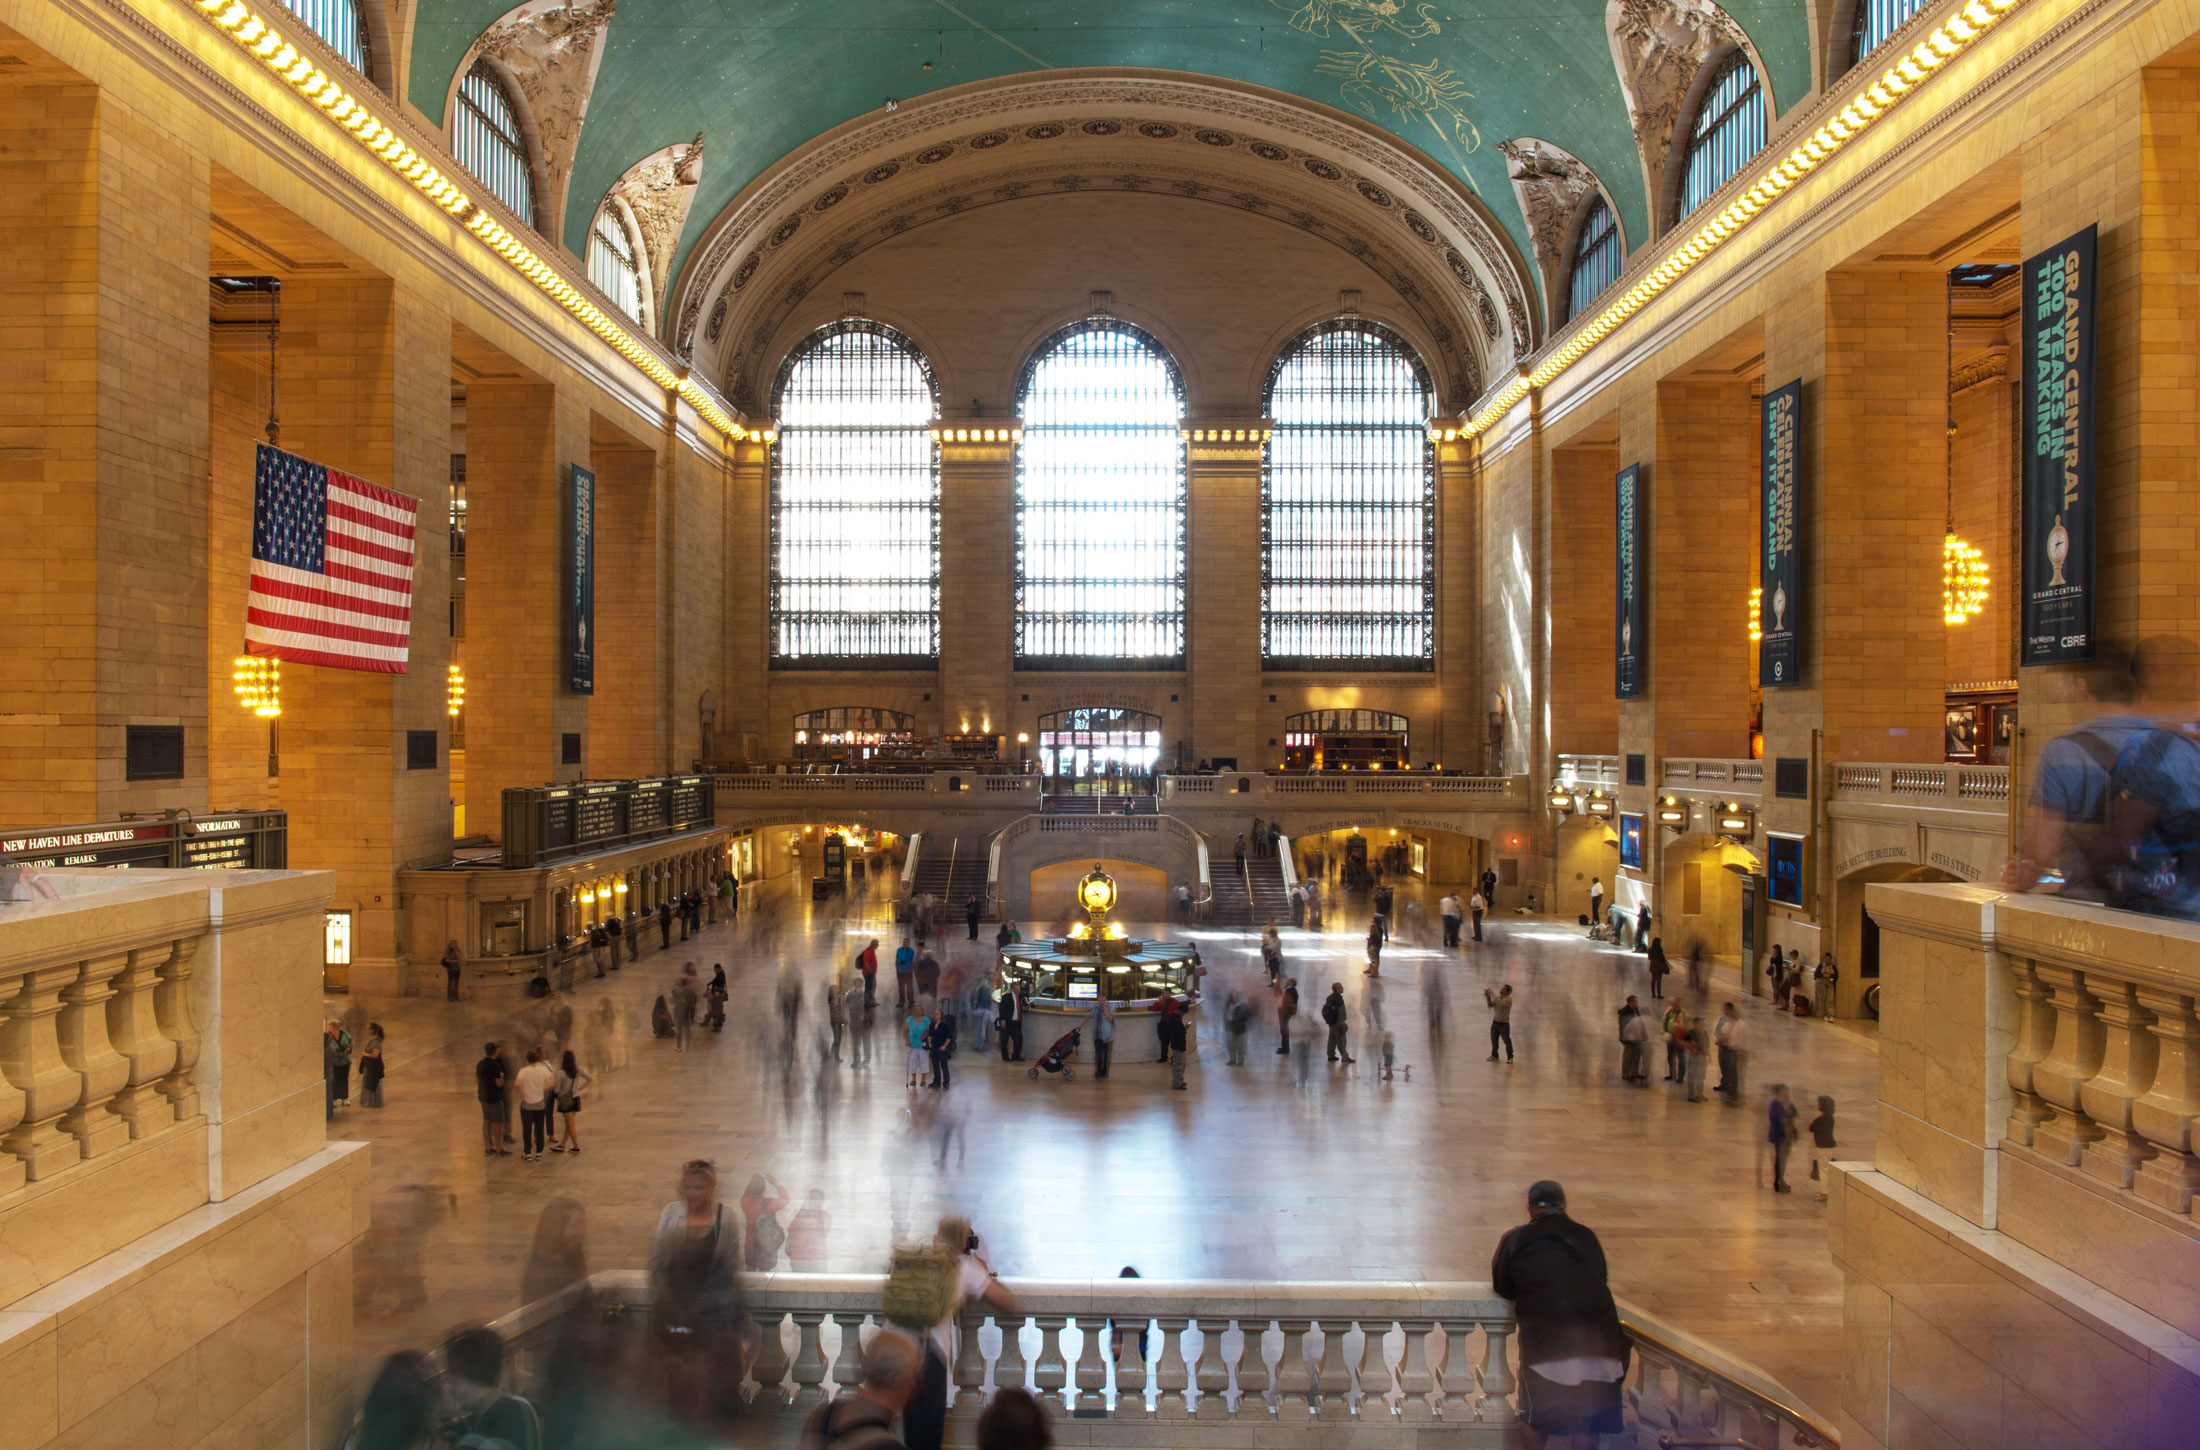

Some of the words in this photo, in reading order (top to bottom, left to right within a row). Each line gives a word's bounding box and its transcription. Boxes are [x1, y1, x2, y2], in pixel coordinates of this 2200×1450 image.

[2037, 260, 2051, 321] THE
[2050, 254, 2065, 313] 100
[2065, 250, 2080, 363] GRAND
[2051, 314, 2065, 420] YEARS
[1785, 393, 1793, 412] A
[2037, 332, 2051, 457] MAKING
[1768, 400, 1777, 459] ISN'T
[2051, 427, 2064, 460] IN
[2064, 368, 2080, 511] CENTRAL
[1768, 463, 1776, 484] IT
[1776, 396, 1785, 552] CELEBRATION
[1784, 414, 1793, 557] CENTENNIAL
[1768, 489, 1776, 570] GRAND
[2032, 590, 2053, 599] GRAND
[2054, 585, 2082, 596] CENTRAL
[2054, 601, 2072, 610] YEARS
[2061, 634, 2086, 648] CBRE
[196, 819, 241, 833] NFORMATION
[1308, 823, 1333, 832] TICKET
[1336, 818, 1376, 827] MACHINES
[1402, 818, 1432, 826] TRACKS
[1441, 822, 1453, 830] TO
[3, 840, 27, 852] NEW
[28, 836, 61, 849] HAVEN
[62, 834, 83, 846] LINE
[84, 829, 134, 844] DEPARTURES
[64, 854, 97, 866] REMARKS
[1836, 862, 1848, 874] THE
[1849, 850, 1874, 868] METLIFE
[1875, 847, 1907, 859] BUILDING
[1930, 852, 1949, 867] 45TH
[1951, 859, 1981, 881] STREET
